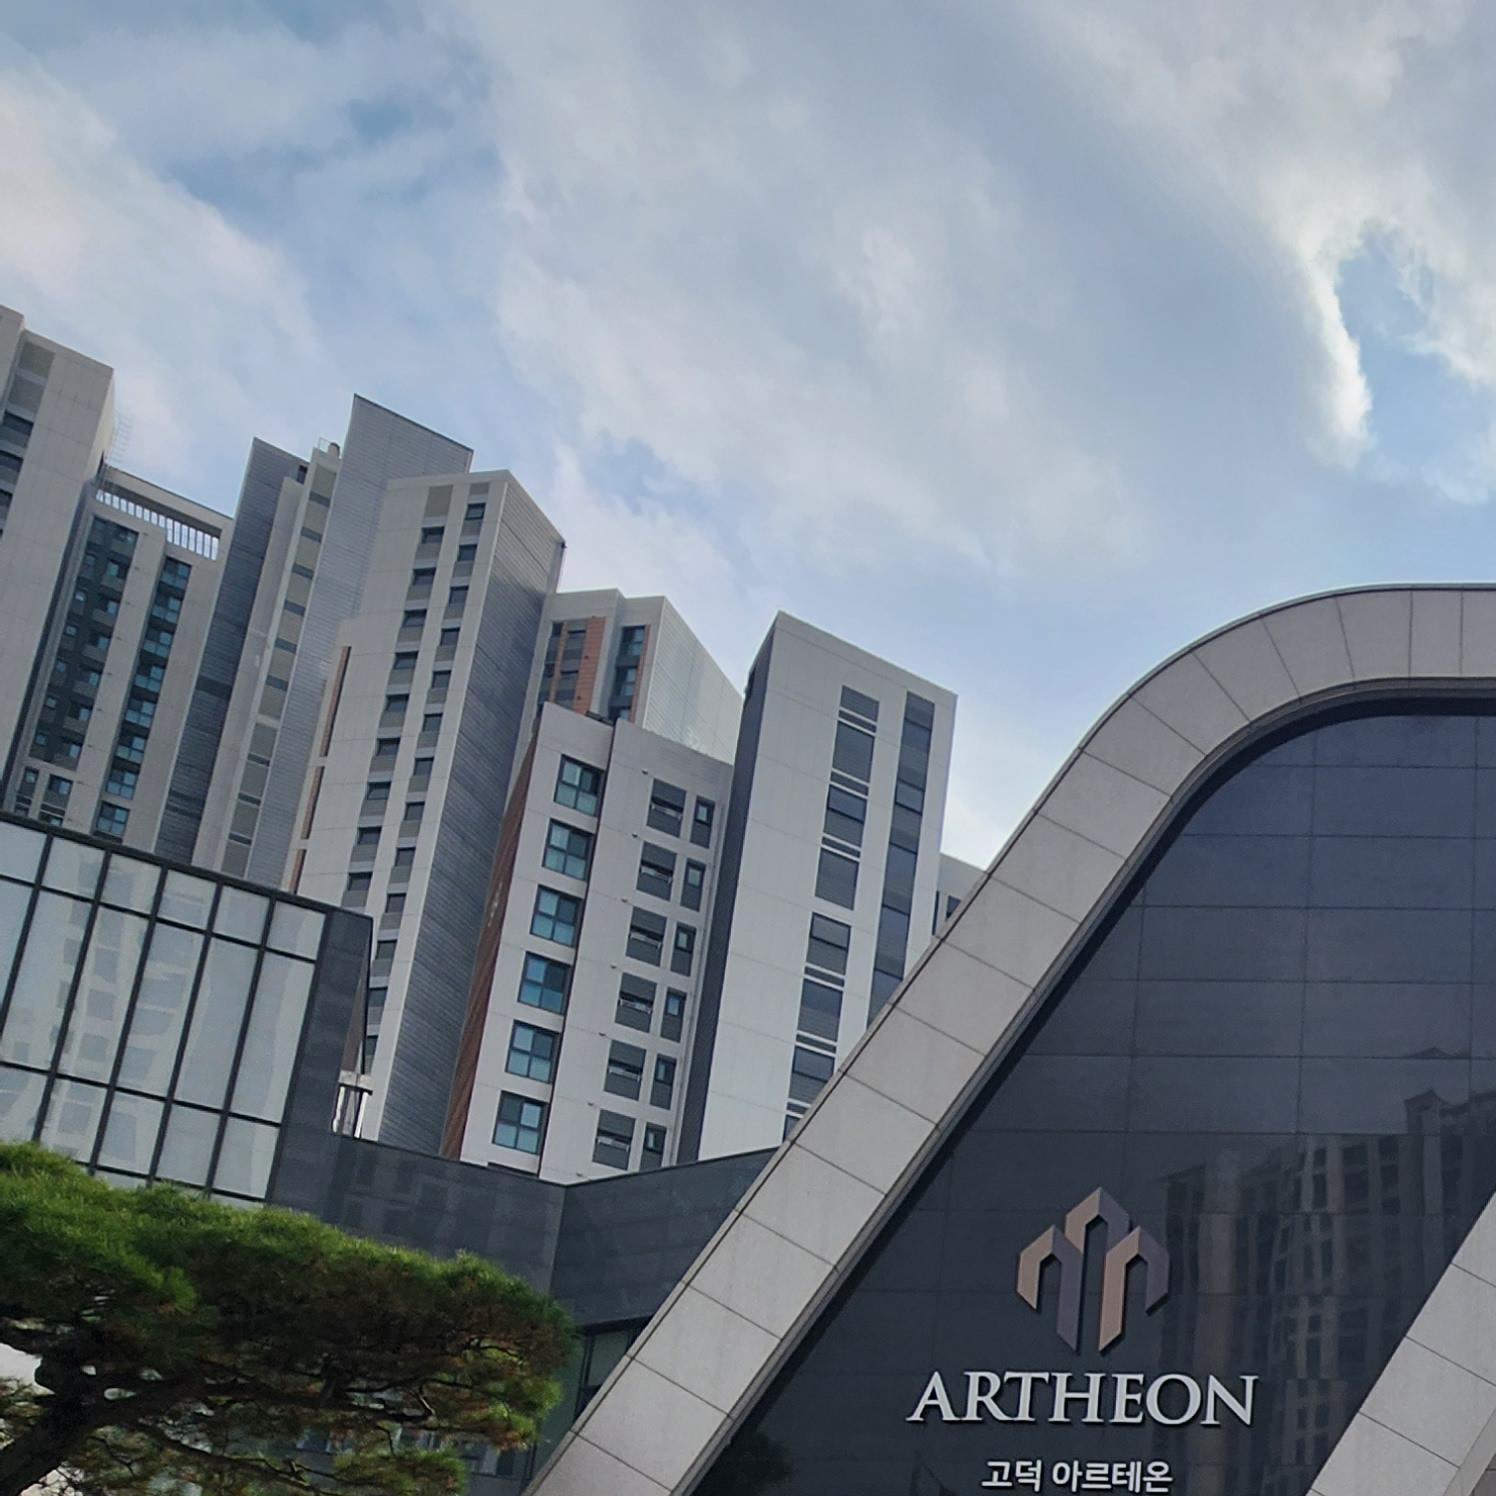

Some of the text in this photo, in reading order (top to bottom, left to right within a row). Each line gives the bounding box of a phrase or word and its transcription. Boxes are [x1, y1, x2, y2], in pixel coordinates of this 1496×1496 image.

[906, 1370, 1259, 1426] ARTHEON
[981, 1458, 1173, 1493] 고덕 아르테온
